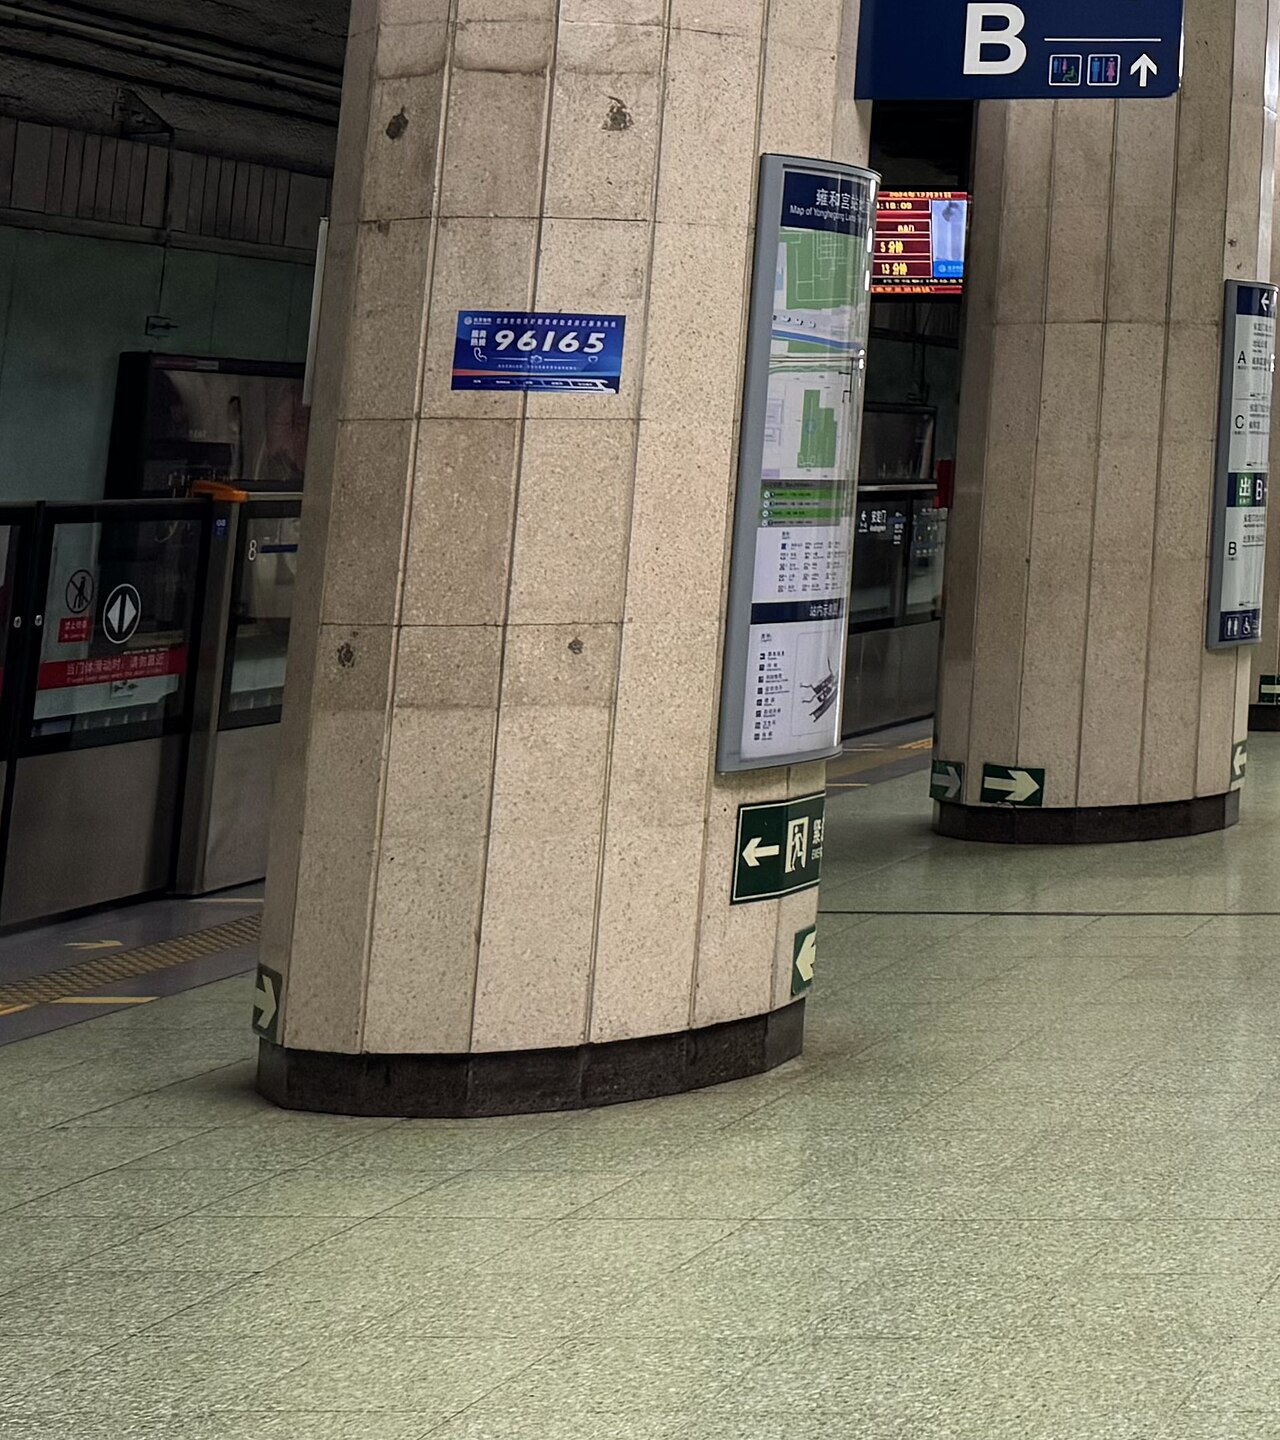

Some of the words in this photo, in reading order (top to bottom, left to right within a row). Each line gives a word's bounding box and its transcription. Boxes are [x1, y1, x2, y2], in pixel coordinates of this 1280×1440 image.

[962, 2, 1027, 76] B
[789, 204, 805, 216] Map
[805, 207, 813, 216] of
[494, 329, 607, 354] 96165
[1237, 350, 1247, 365] A
[1234, 414, 1245, 430] C
[248, 539, 257, 562] 8
[1228, 541, 1237, 556] B
